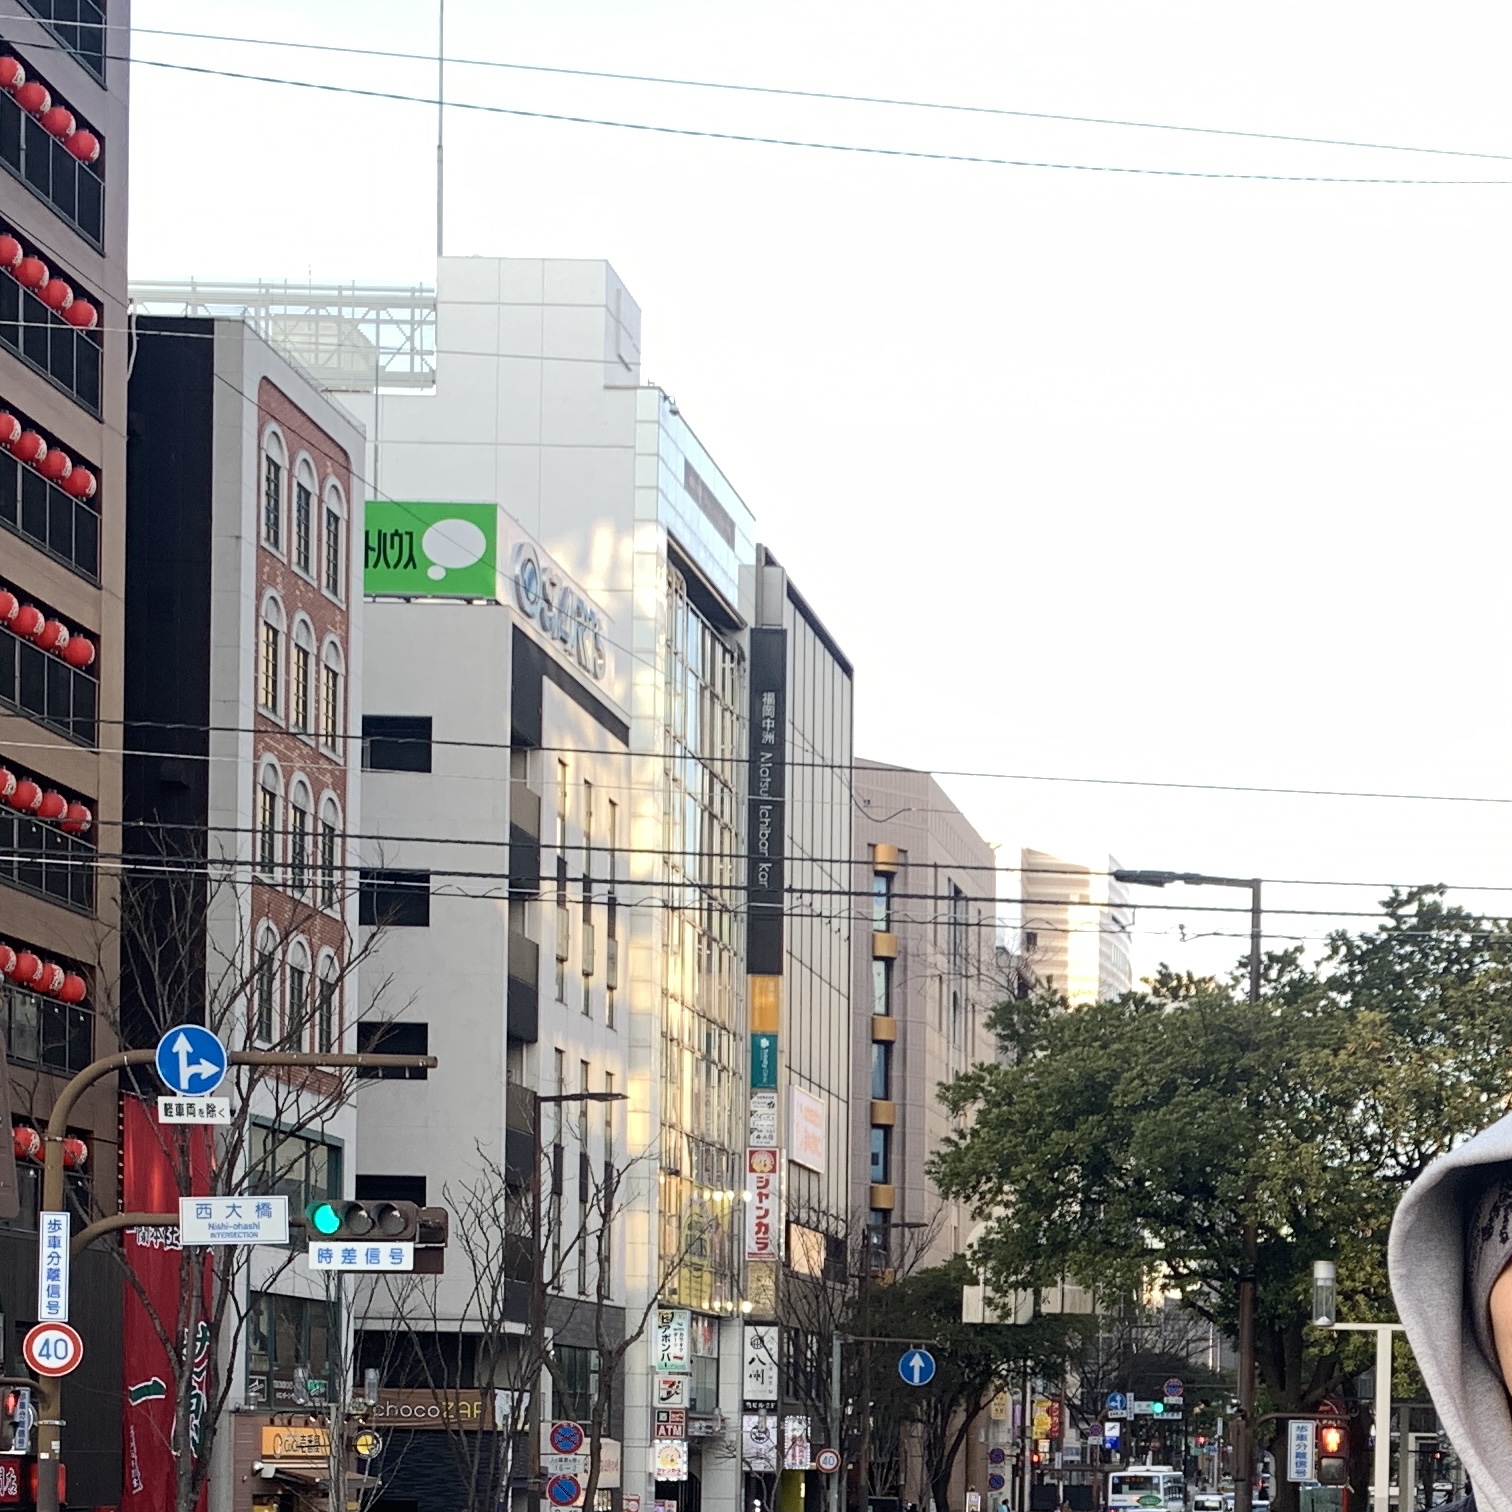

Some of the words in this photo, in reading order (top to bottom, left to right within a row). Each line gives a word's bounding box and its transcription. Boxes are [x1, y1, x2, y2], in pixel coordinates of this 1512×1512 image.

[163, 1102, 225, 1118] 軽車両を除く
[195, 1202, 273, 1219] 西大橋
[754, 1175, 770, 1251] ジャンカラ
[208, 1221, 261, 1231] Nishi-ohashi
[317, 1247, 405, 1266] 時差信号
[46, 1219, 63, 1316] 歩車分離信号
[37, 1338, 69, 1360] 40
[657, 1426, 683, 1436] ATM
[822, 1455, 835, 1465] 40
